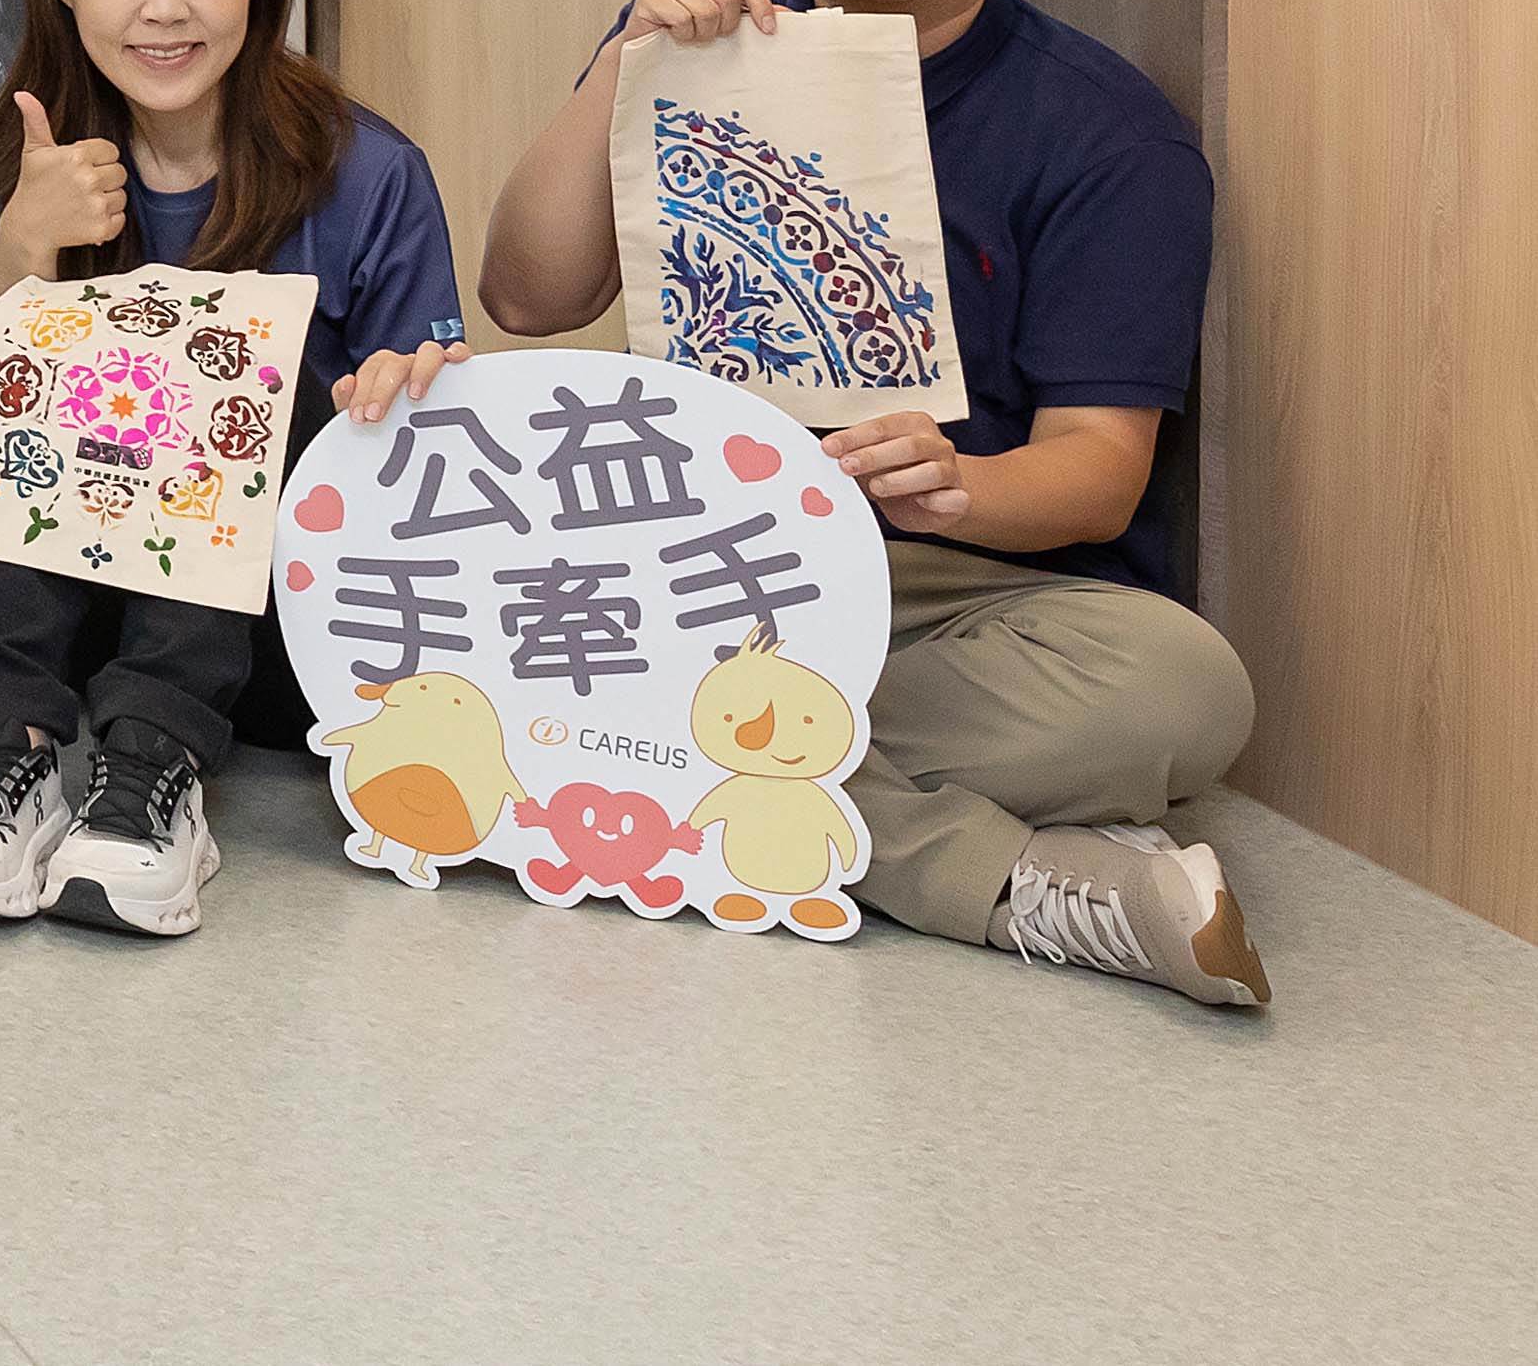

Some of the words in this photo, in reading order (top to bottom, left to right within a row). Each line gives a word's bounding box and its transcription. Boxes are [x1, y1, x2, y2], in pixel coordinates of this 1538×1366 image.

[376, 376, 708, 541] 公益
[327, 511, 822, 698] 手牽手
[578, 728, 689, 770] CAREUS
